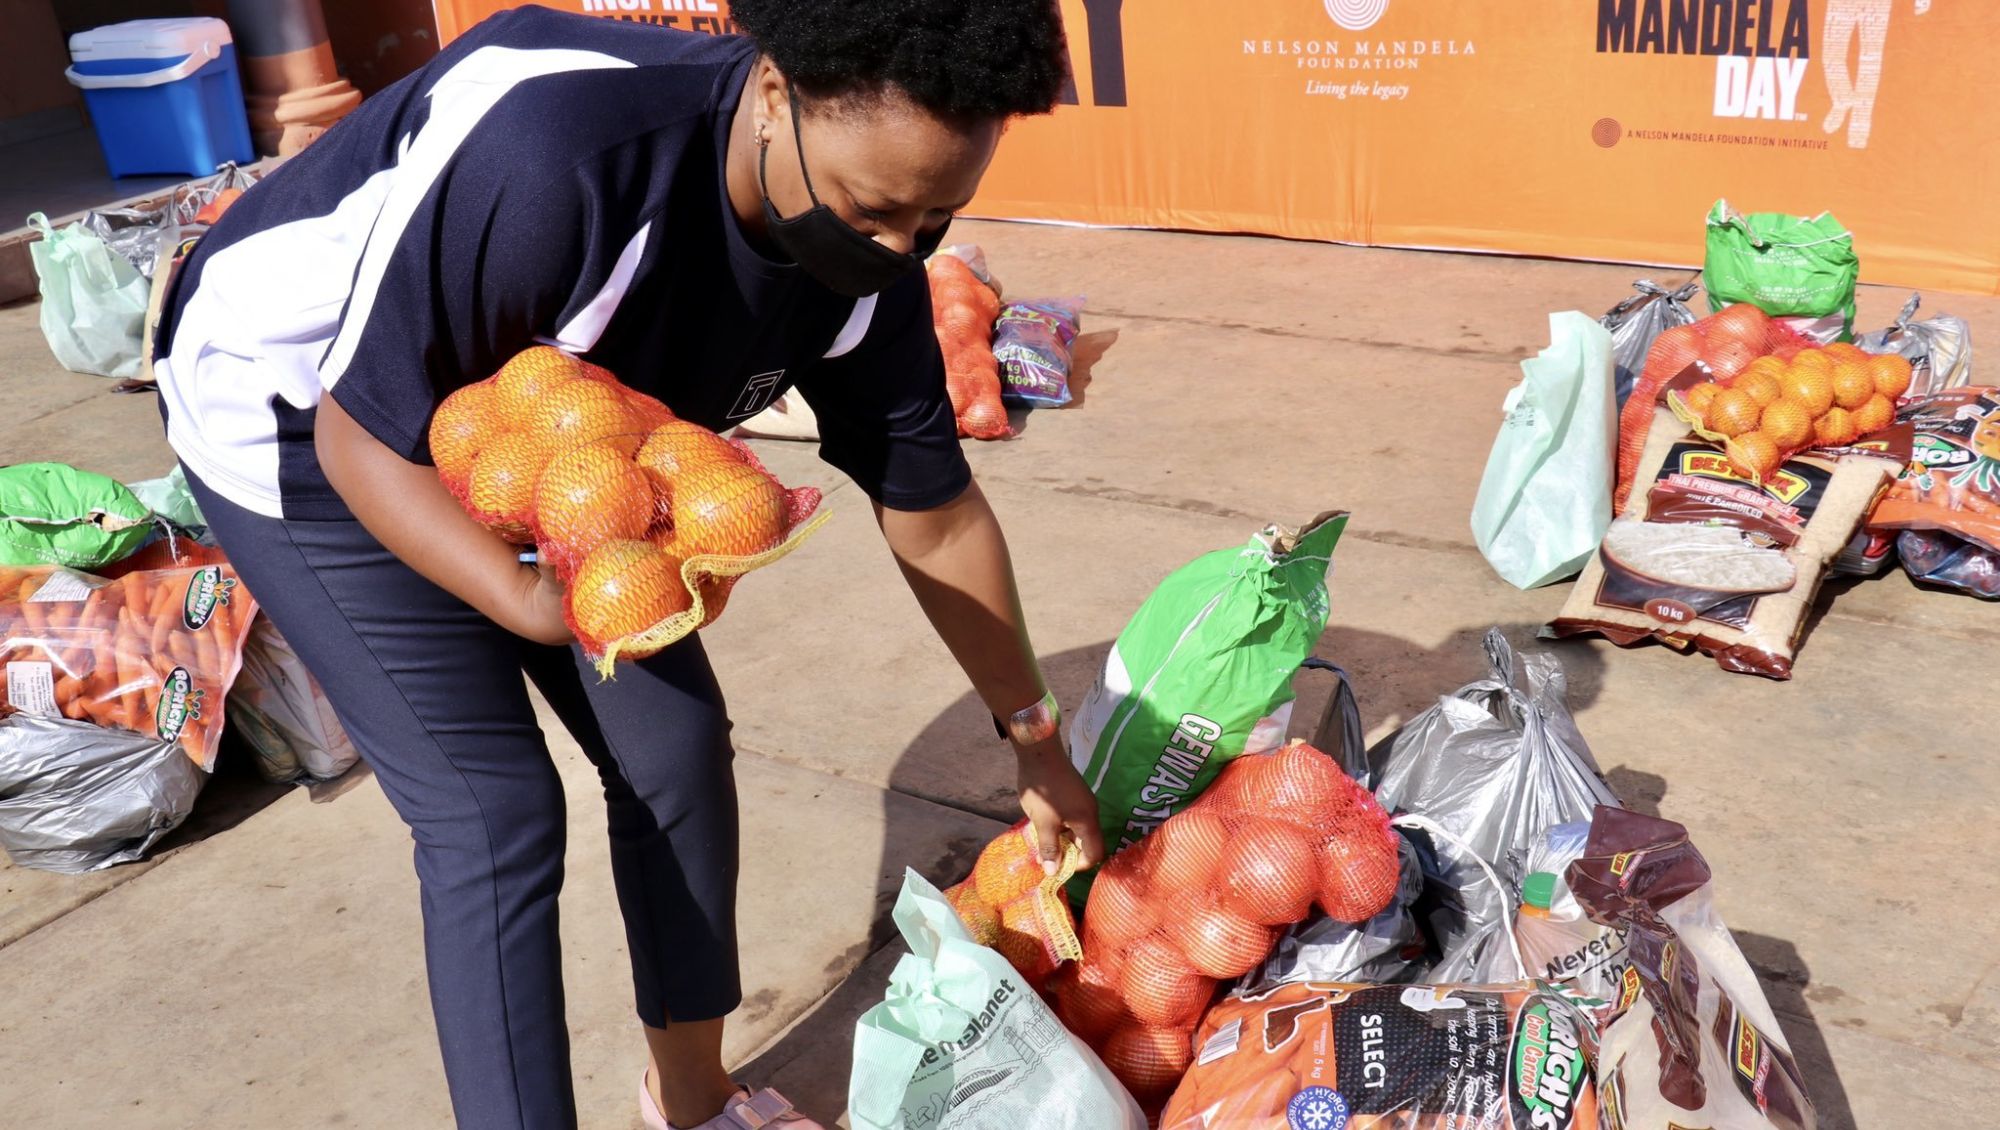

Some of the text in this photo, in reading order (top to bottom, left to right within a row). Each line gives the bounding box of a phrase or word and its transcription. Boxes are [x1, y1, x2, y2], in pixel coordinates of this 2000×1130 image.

[1596, 0, 1809, 59] MANDELA
[1243, 40, 1476, 55] NELSON MANDELA
[1297, 58, 1419, 69] FOUNDATION
[1306, 80, 1409, 99] Living the legacy
[1713, 55, 1808, 120] DAY
[1627, 130, 1829, 150] A NELSON MANDELA FOUNDATION INITIATIVE
[1671, 476, 1797, 516] THAI PREMIUM GRADE RICE
[1657, 605, 1683, 621] 10 kg
[163, 669, 188, 741] RORICH'S
[1546, 931, 1611, 980] Never
[1448, 1019, 1461, 1033] the
[1464, 1008, 1479, 1038] keeping
[1360, 1014, 1386, 1089] SELECT
[1448, 1035, 1462, 1052] soil
[1519, 1014, 1546, 1099] Cool Carrots
[1486, 1048, 1496, 1066] are
[1315, 1087, 1346, 1113] HYDRO
